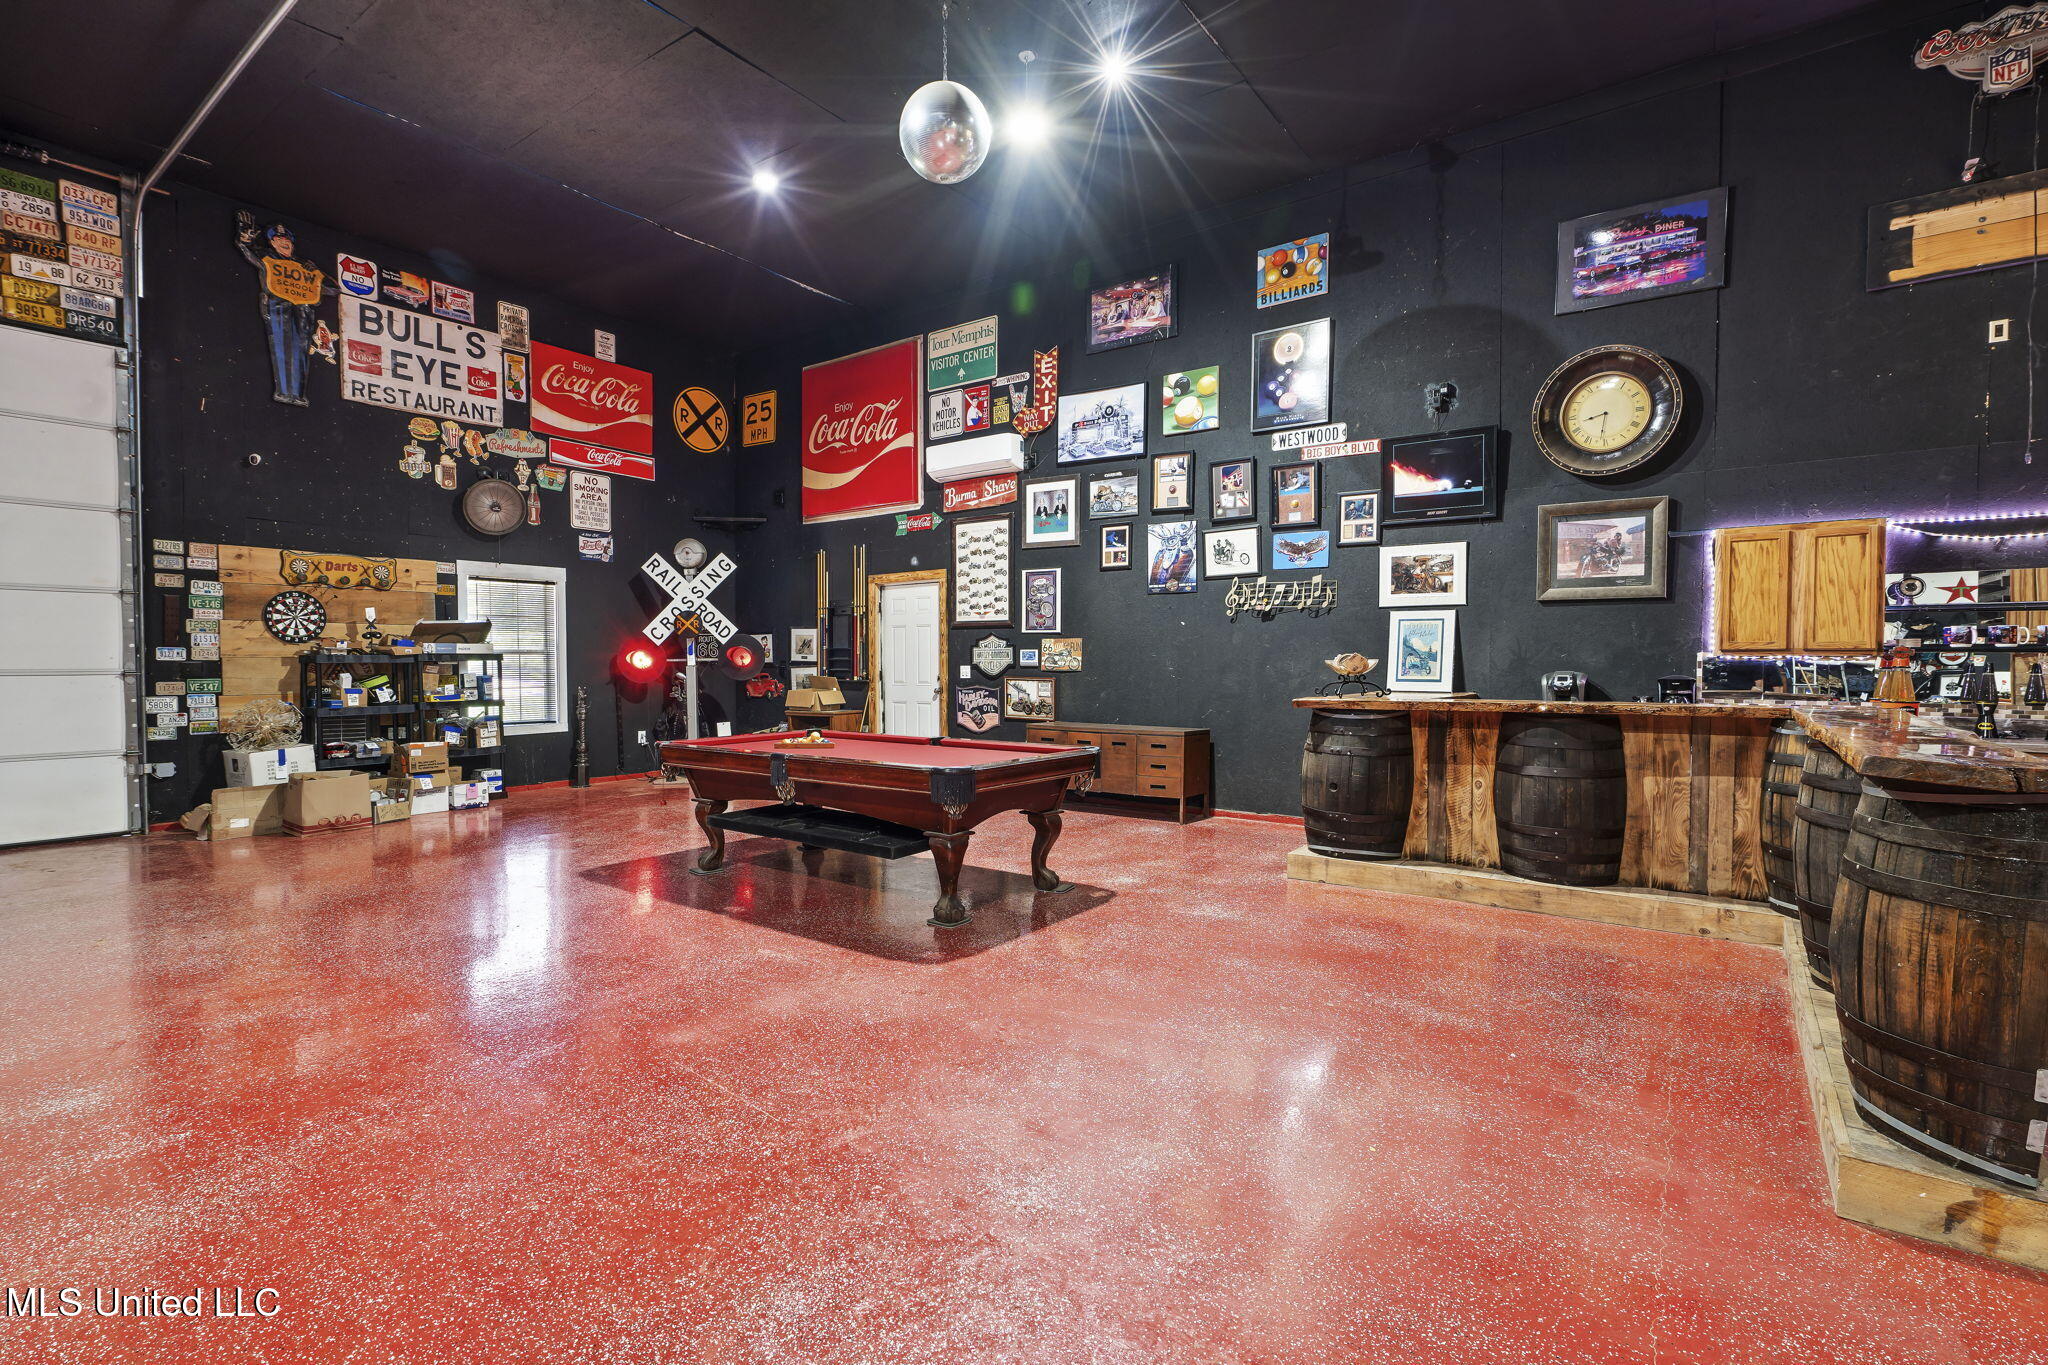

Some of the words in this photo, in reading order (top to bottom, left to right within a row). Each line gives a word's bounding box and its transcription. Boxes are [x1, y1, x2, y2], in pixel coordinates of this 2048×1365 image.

[1993, 61, 2027, 82] NFL
[92, 194, 114, 209] CPC
[69, 209, 89, 223] 953
[1654, 220, 1685, 233] DINER
[101, 236, 116, 249] RP
[18, 260, 32, 272] 19
[51, 267, 64, 279] 88
[272, 264, 316, 285] SLOW
[76, 272, 90, 285] 62
[94, 276, 114, 290] 913
[277, 278, 313, 292] SCHOOL
[352, 274, 365, 284] NO
[285, 287, 307, 298] ZONE
[1260, 280, 1324, 305] BILLIARDS
[503, 304, 525, 318] PRIVATE
[359, 303, 486, 359] BULL'S
[500, 321, 528, 336] CROSSING
[931, 336, 951, 351] Tour
[951, 324, 994, 346] Memphis
[930, 354, 960, 371] VISITOR
[963, 345, 995, 364] CENTER
[391, 348, 462, 392] EYE
[573, 360, 595, 375] Enjoy
[470, 376, 491, 389] Coke
[541, 363, 642, 414] Coca-Cola
[1039, 357, 1053, 422] EXIT
[351, 379, 497, 423] RESTAURANT
[834, 402, 854, 413] Enjoy
[941, 396, 951, 408] NO
[680, 407, 688, 423] R
[714, 416, 722, 432] R
[746, 399, 772, 425] 25
[935, 407, 957, 421] MOTOR
[1023, 412, 1039, 421] WAY
[808, 396, 904, 454] Coca-Cola
[932, 417, 961, 432] VEHICLES
[1023, 420, 1039, 428] OUT
[750, 428, 768, 441] MPH
[1278, 426, 1340, 448] WESTWOOD
[587, 448, 623, 467] Coca-Cola
[1306, 447, 1323, 459] BIG
[1324, 445, 1341, 457] BOY
[1351, 441, 1375, 453] BLVD
[584, 476, 598, 486] NO
[574, 483, 609, 496] SMOKING
[580, 492, 603, 502] AREA
[945, 487, 977, 508] Burma
[984, 479, 1016, 498] Shave
[324, 560, 359, 573] Darts
[191, 599, 221, 609] VE-146
[650, 558, 733, 641] CROSSING
[697, 642, 719, 658] 66
[1043, 643, 1053, 653] 66
[189, 682, 219, 691] VE-147
